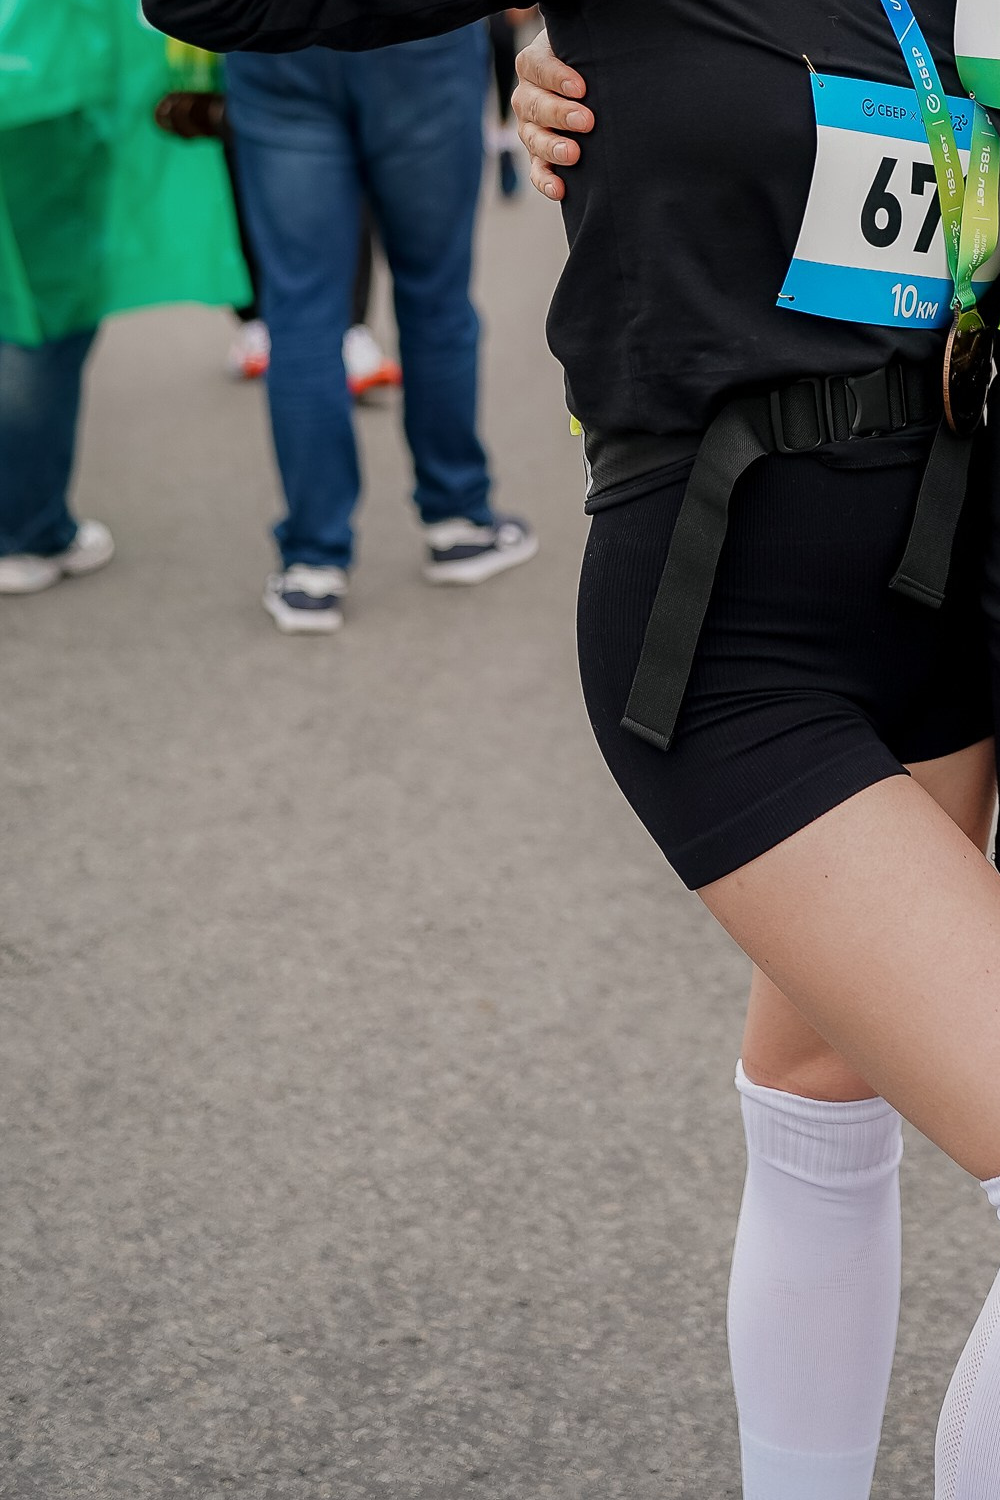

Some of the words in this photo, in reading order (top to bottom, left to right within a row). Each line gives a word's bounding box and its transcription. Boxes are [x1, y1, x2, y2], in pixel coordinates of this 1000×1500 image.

[912, 46, 933, 90] СБЕР
[877, 104, 907, 119] СБЕР
[940, 134, 951, 164] лет
[980, 146, 990, 174] 185
[946, 168, 956, 198] 185
[977, 177, 985, 207] лет
